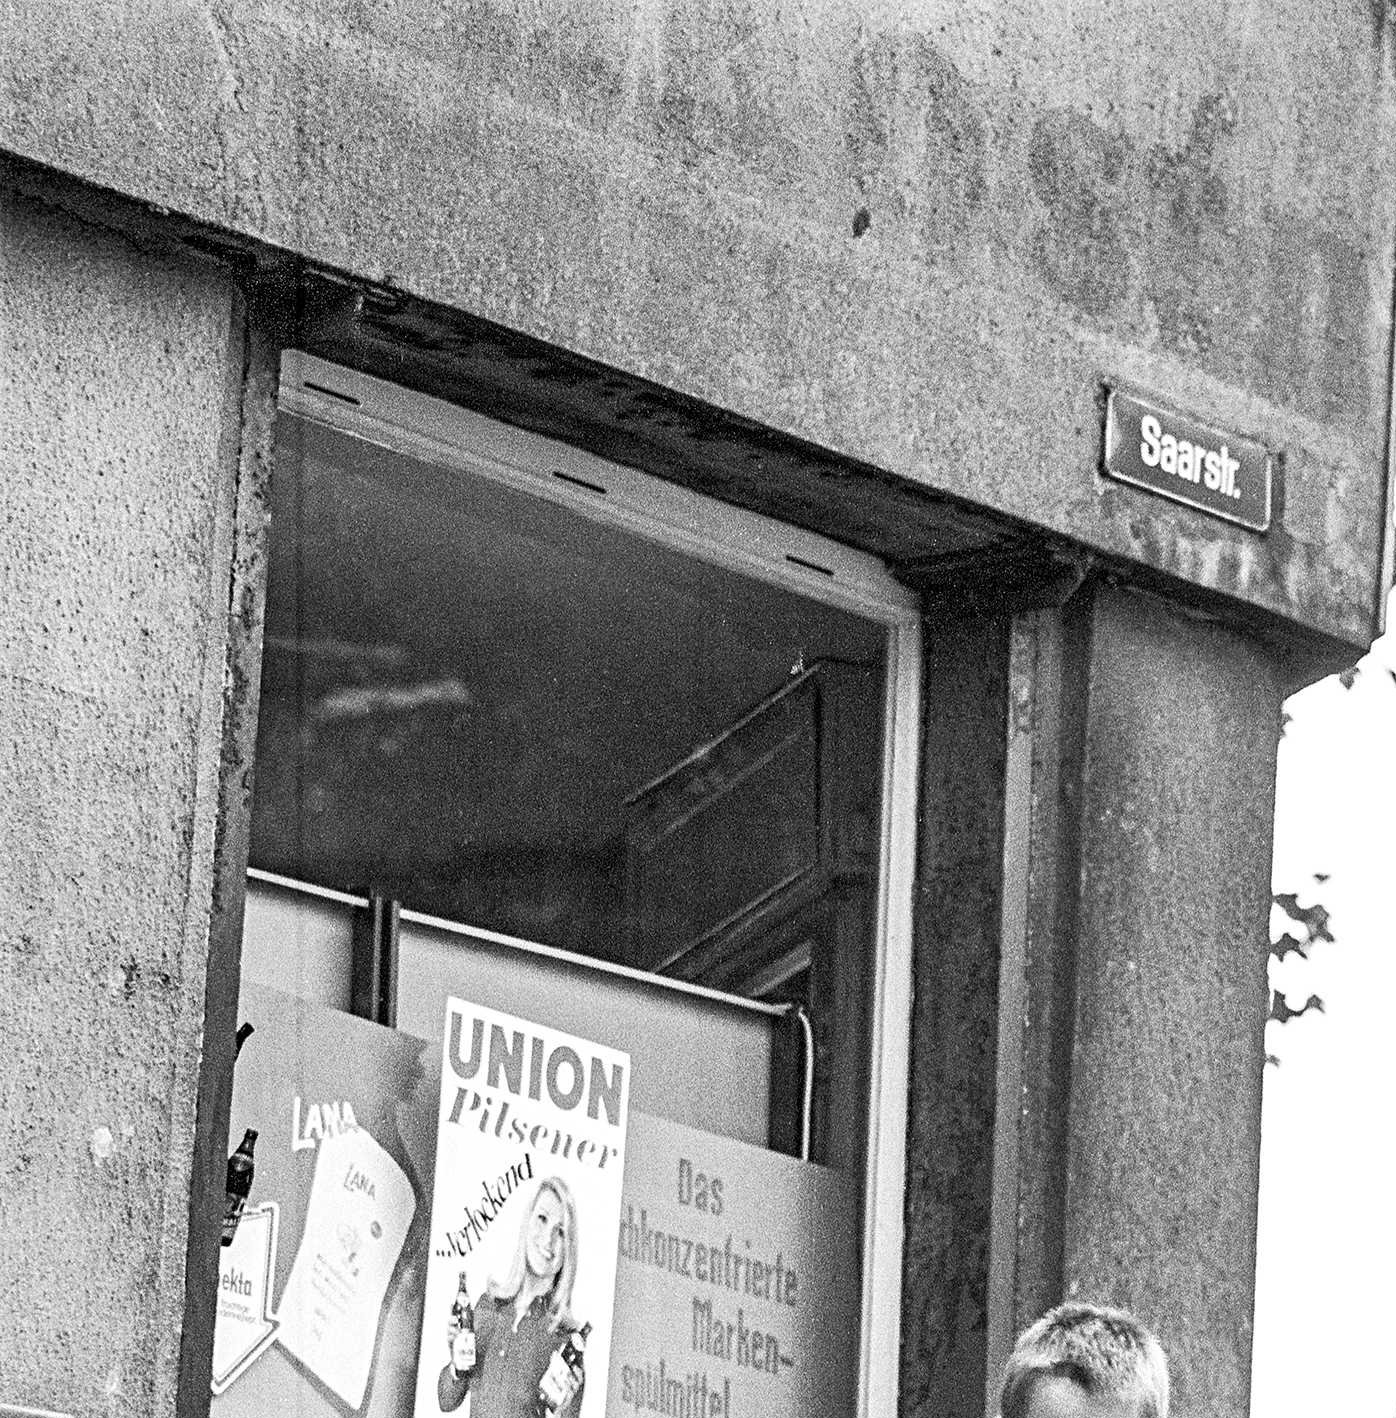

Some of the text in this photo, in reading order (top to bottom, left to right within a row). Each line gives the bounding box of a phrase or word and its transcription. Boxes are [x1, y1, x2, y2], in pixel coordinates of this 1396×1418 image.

[1140, 414, 1242, 499] Saarstr.
[448, 1010, 624, 1128] UNION
[292, 1096, 358, 1152] LANA
[447, 1085, 619, 1170] Pilsener
[343, 1163, 377, 1201] LANA
[677, 1157, 725, 1216] Das
[221, 1266, 253, 1297] ekta
[691, 1295, 796, 1375] Marken-
